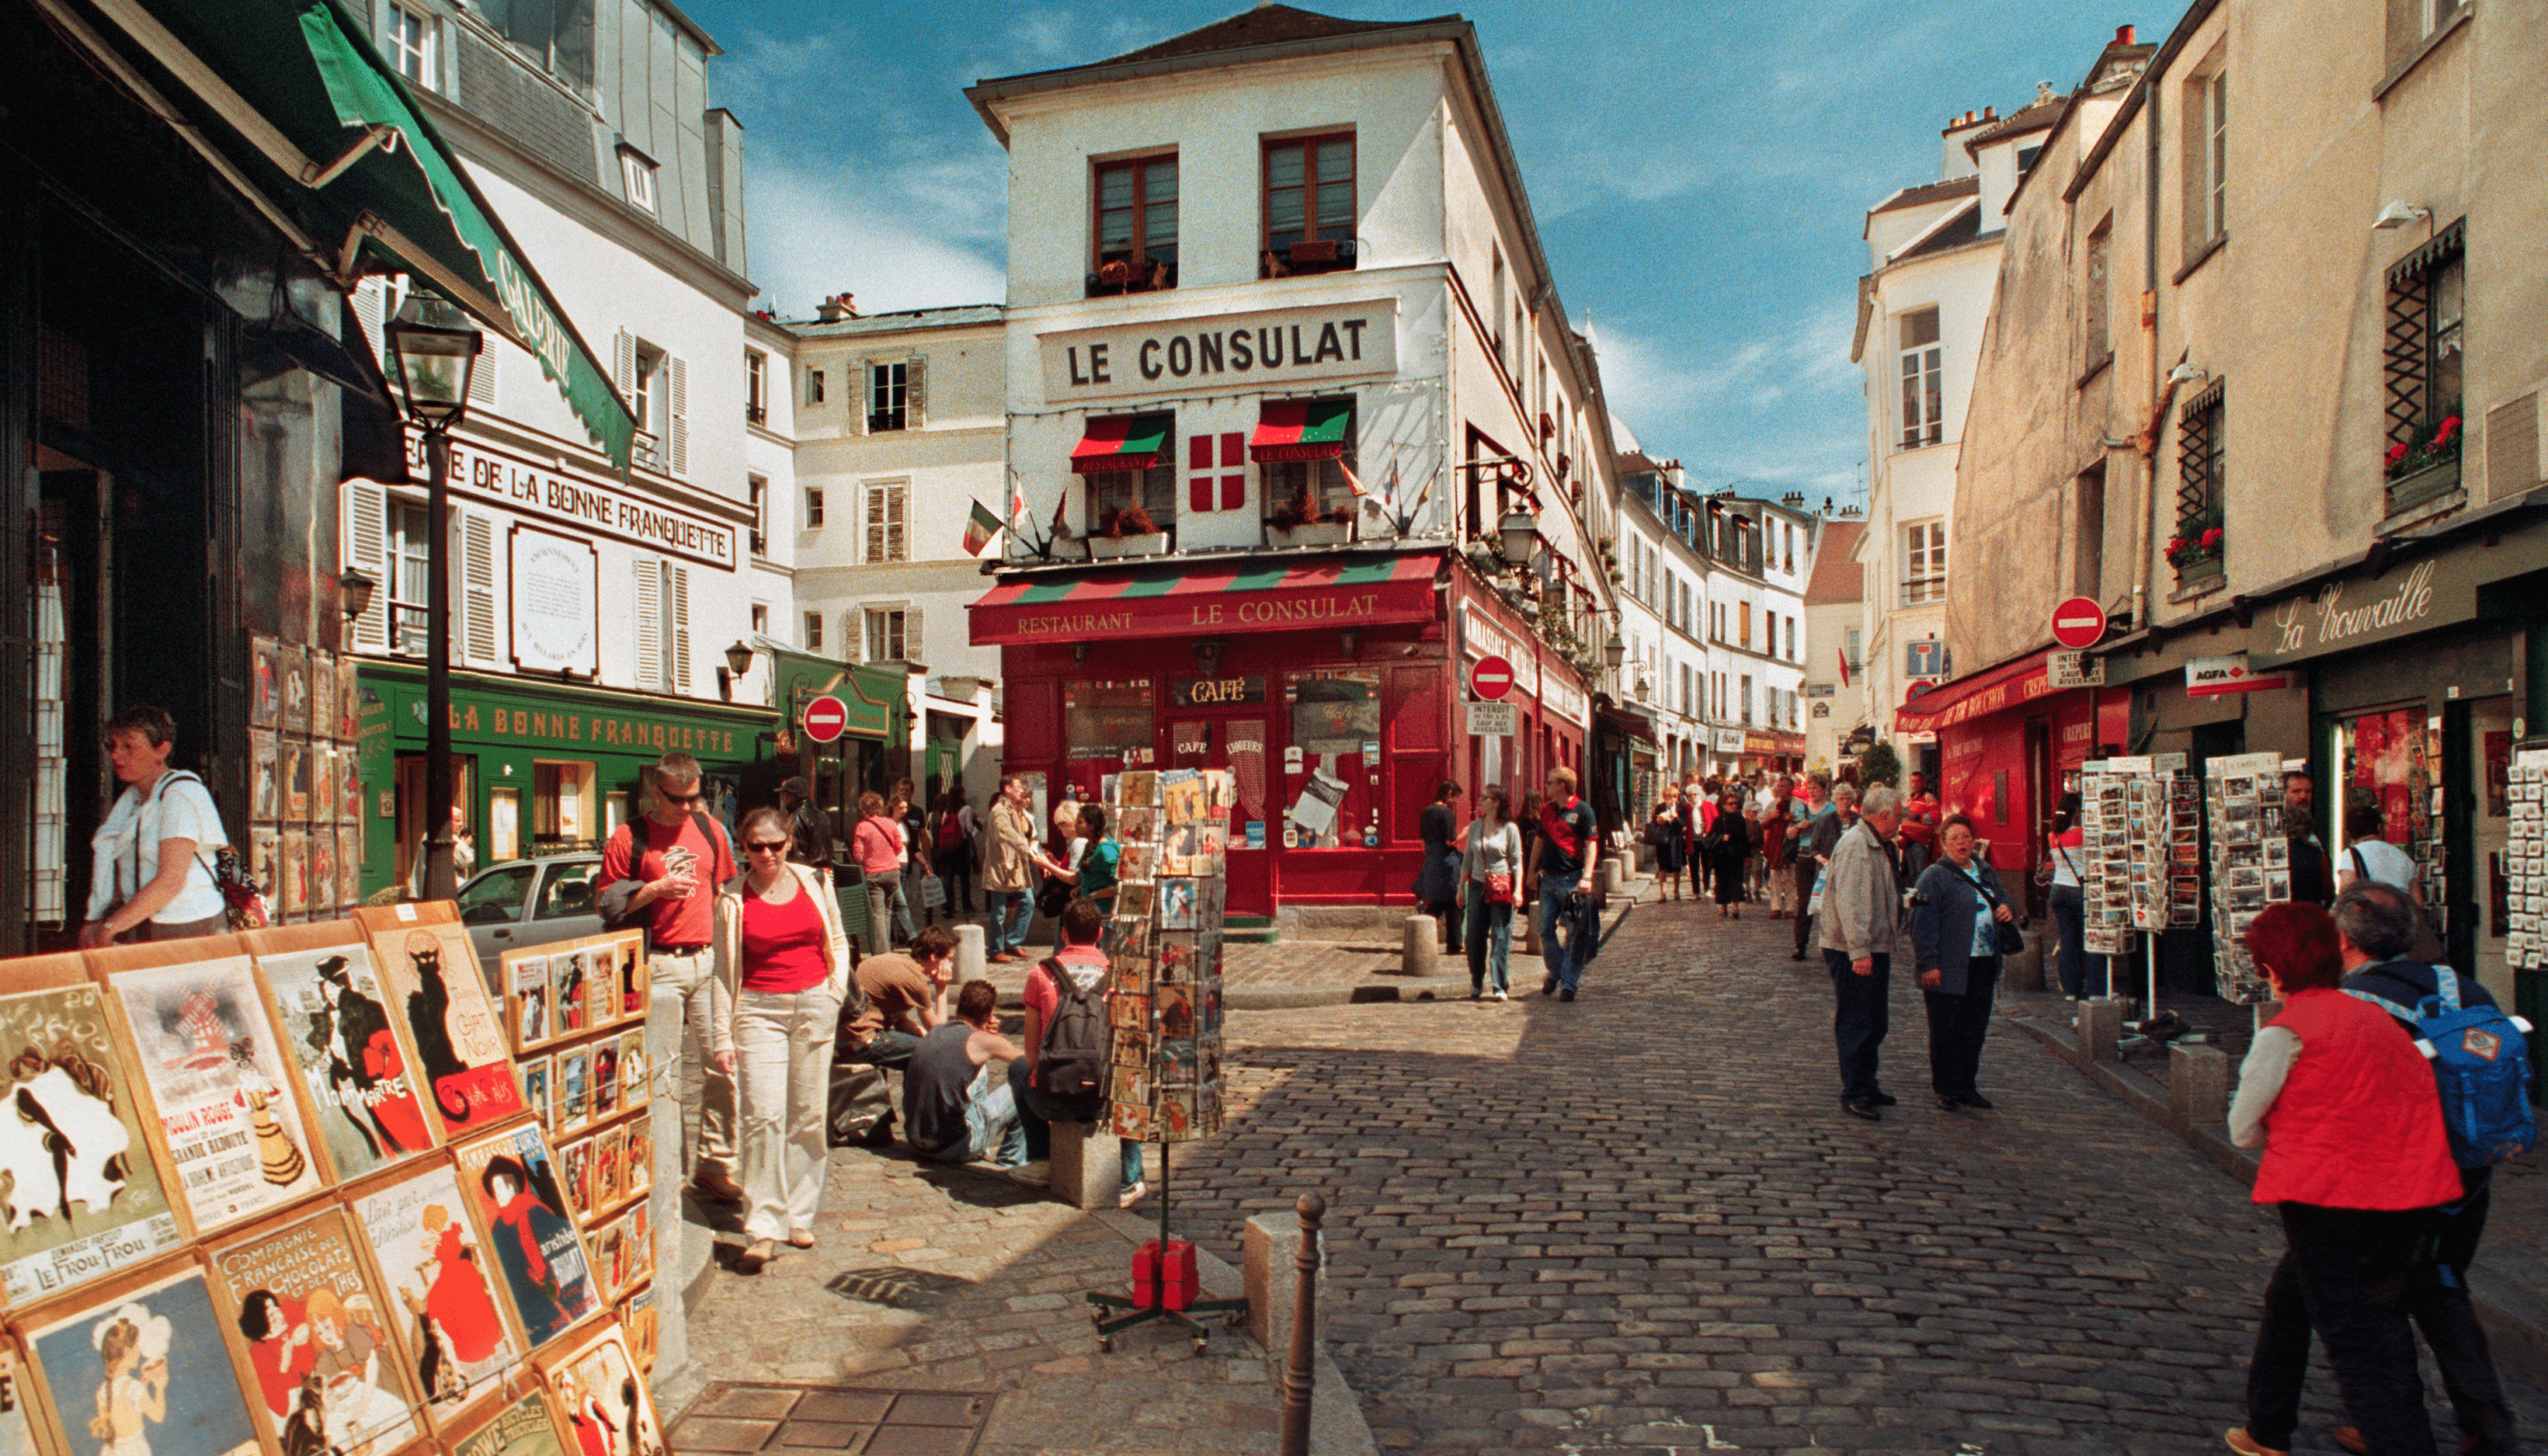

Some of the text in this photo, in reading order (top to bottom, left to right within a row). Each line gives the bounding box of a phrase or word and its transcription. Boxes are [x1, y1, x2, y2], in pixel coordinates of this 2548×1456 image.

[499, 249, 570, 388] GALERIE
[1067, 318, 1368, 386] LE CONSULAT
[1260, 449, 1273, 462] LE
[474, 456, 502, 493] DE
[512, 467, 540, 504] LA
[547, 480, 613, 525] BONNE
[619, 502, 727, 558] FRANQUETTE
[1017, 593, 1379, 635] RESTAURANT LE CONSULAT
[2275, 560, 2435, 654] La Trouvaille
[1191, 677, 1246, 703] CAFÉ
[2059, 676, 2102, 685] RIVERAINS
[2196, 669, 2227, 681] AGFA
[1474, 705, 1509, 714] INTERDIT
[450, 704, 734, 753] LA BONNE FRANQUETTE
[1226, 739, 1264, 754] LIQUEURS
[463, 1035, 503, 1058] NOIR
[304, 1064, 408, 1114] MONTMARTRE
[160, 1110, 200, 1137] MOULIN
[200, 1101, 234, 1126] ROUGE
[170, 1142, 207, 1166] GRANDE
[207, 1131, 249, 1155] REDOUTE
[464, 1128, 541, 1170] AMBASSADEURS
[228, 1204, 238, 1214] 3
[223, 1225, 318, 1276] COMPAGNIE
[320, 1235, 339, 1252] DES
[269, 1245, 352, 1295] CHOCOLATS
[292, 1284, 304, 1298] ET
[308, 1274, 328, 1289] DES
